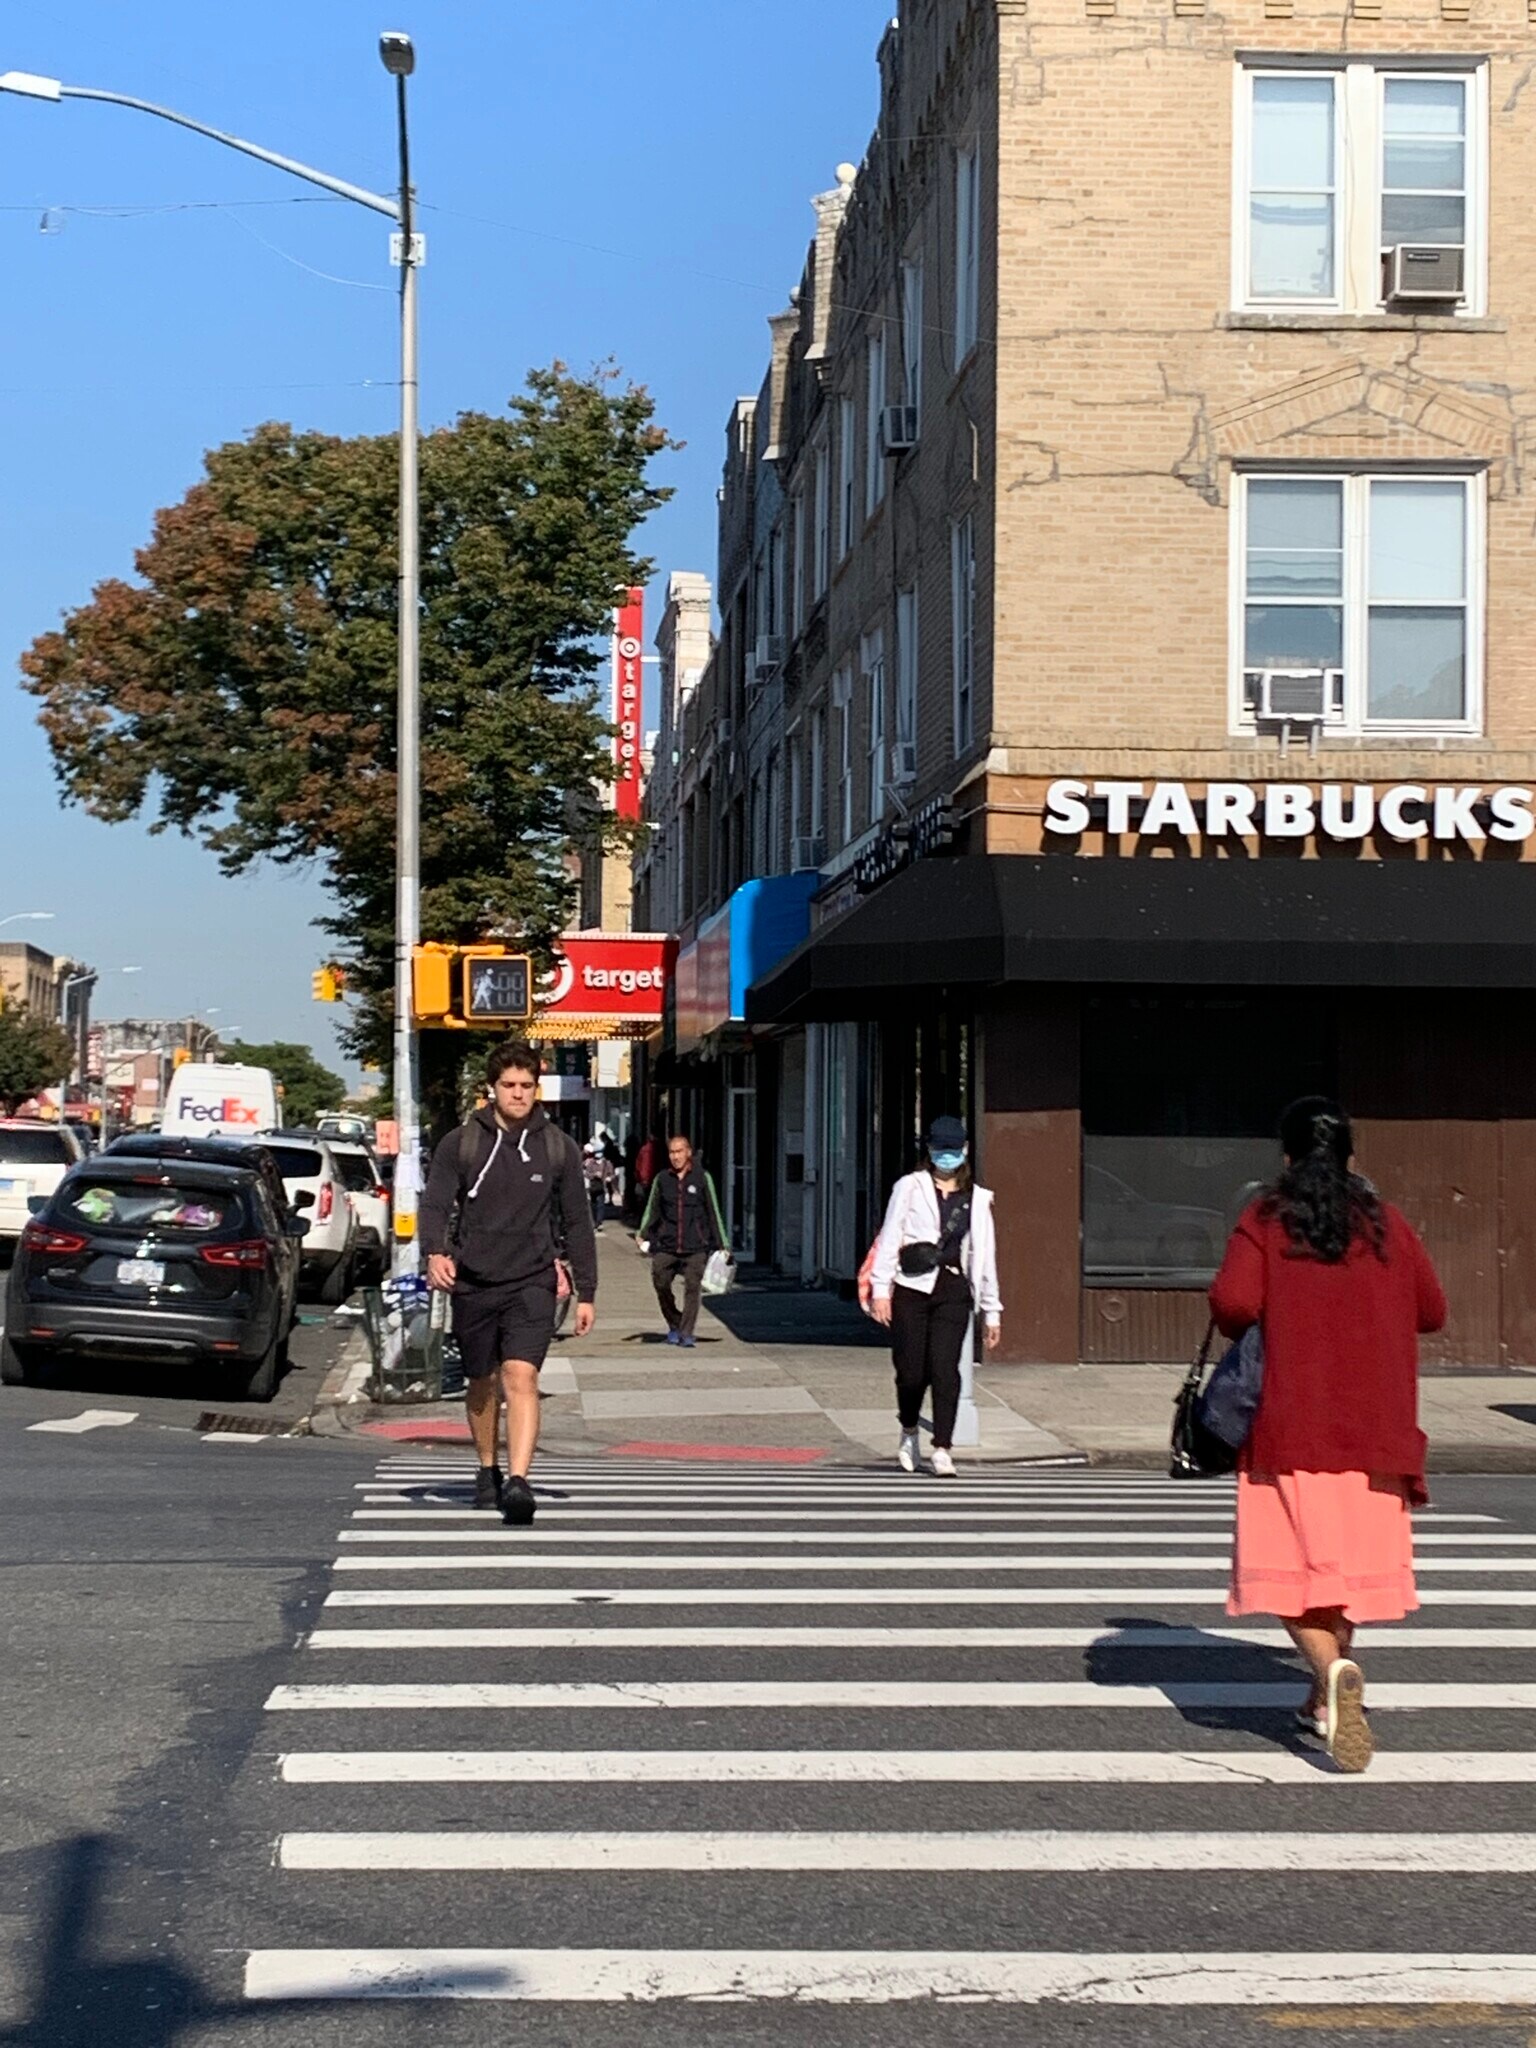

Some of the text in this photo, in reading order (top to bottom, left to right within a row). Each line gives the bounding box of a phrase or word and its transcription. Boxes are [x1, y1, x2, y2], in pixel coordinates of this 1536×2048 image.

[1044, 780, 1534, 841] STARBUCKS
[583, 965, 663, 992] target
[179, 1097, 259, 1125] FedEx
